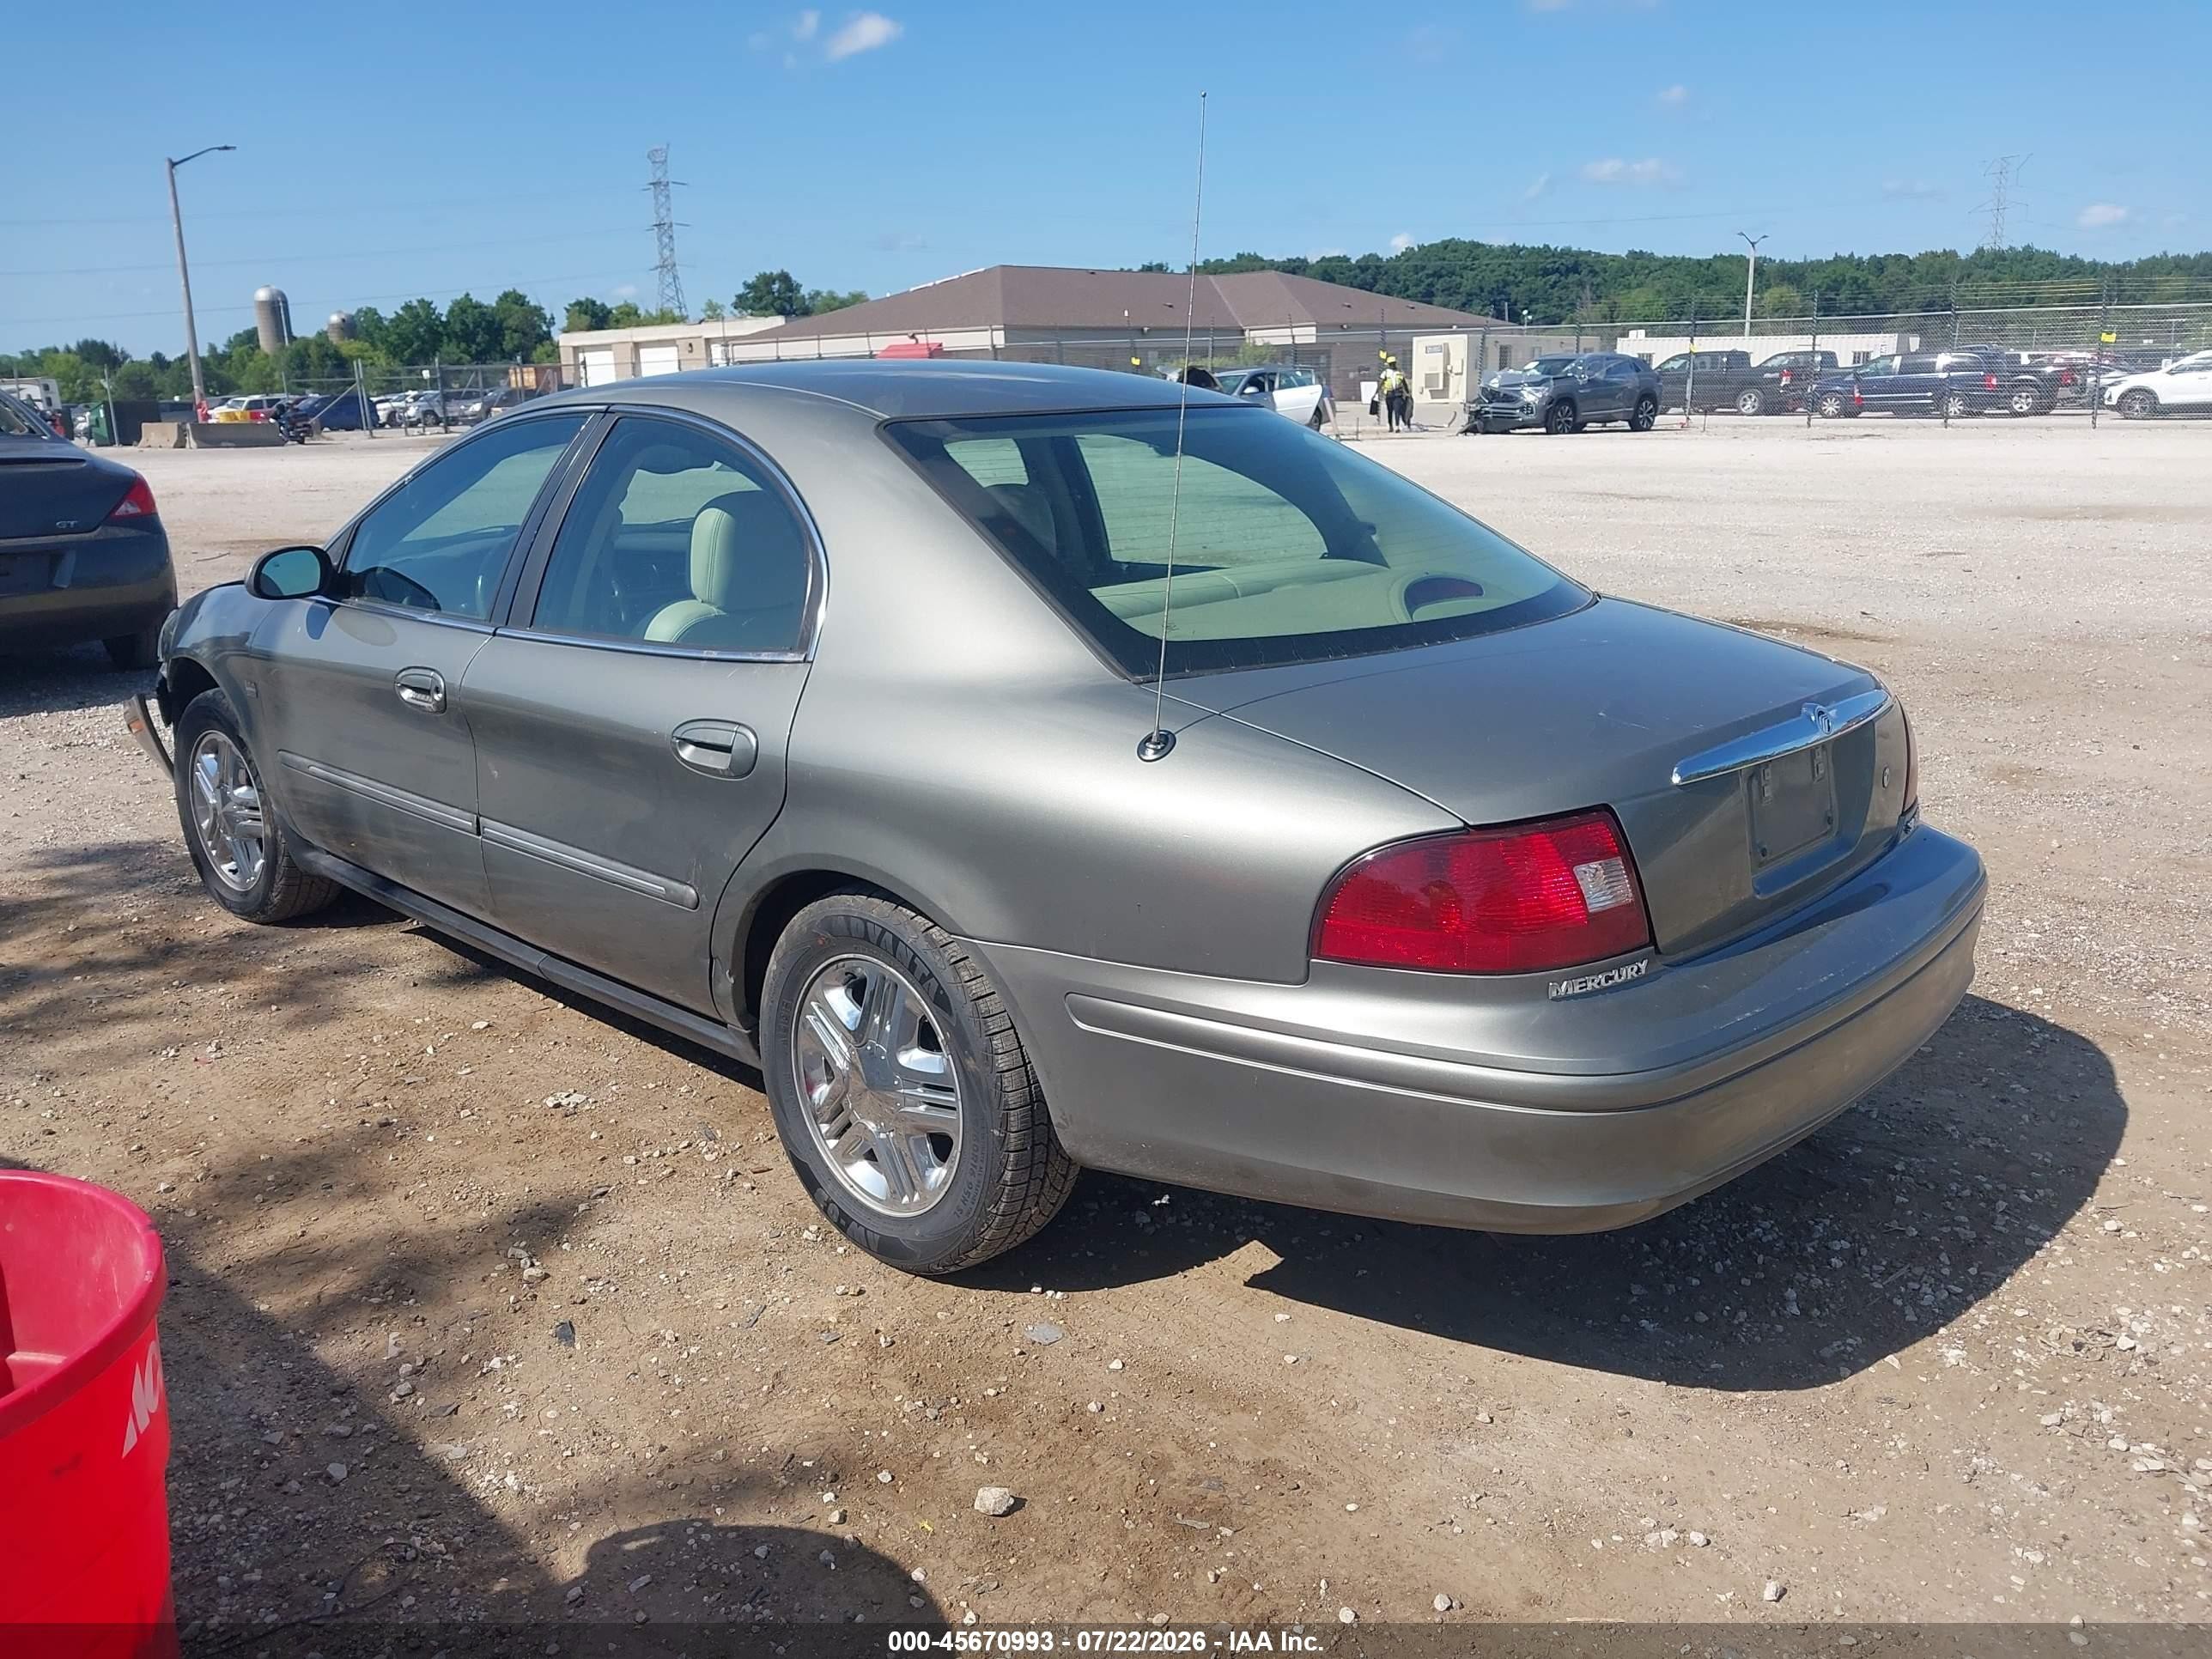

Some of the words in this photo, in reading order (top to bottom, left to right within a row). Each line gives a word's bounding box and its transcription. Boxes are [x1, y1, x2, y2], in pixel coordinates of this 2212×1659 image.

[55, 520, 78, 529] GT
[830, 915, 942, 1003] ADVANTA
[1547, 958, 1649, 1000] MERCURY
